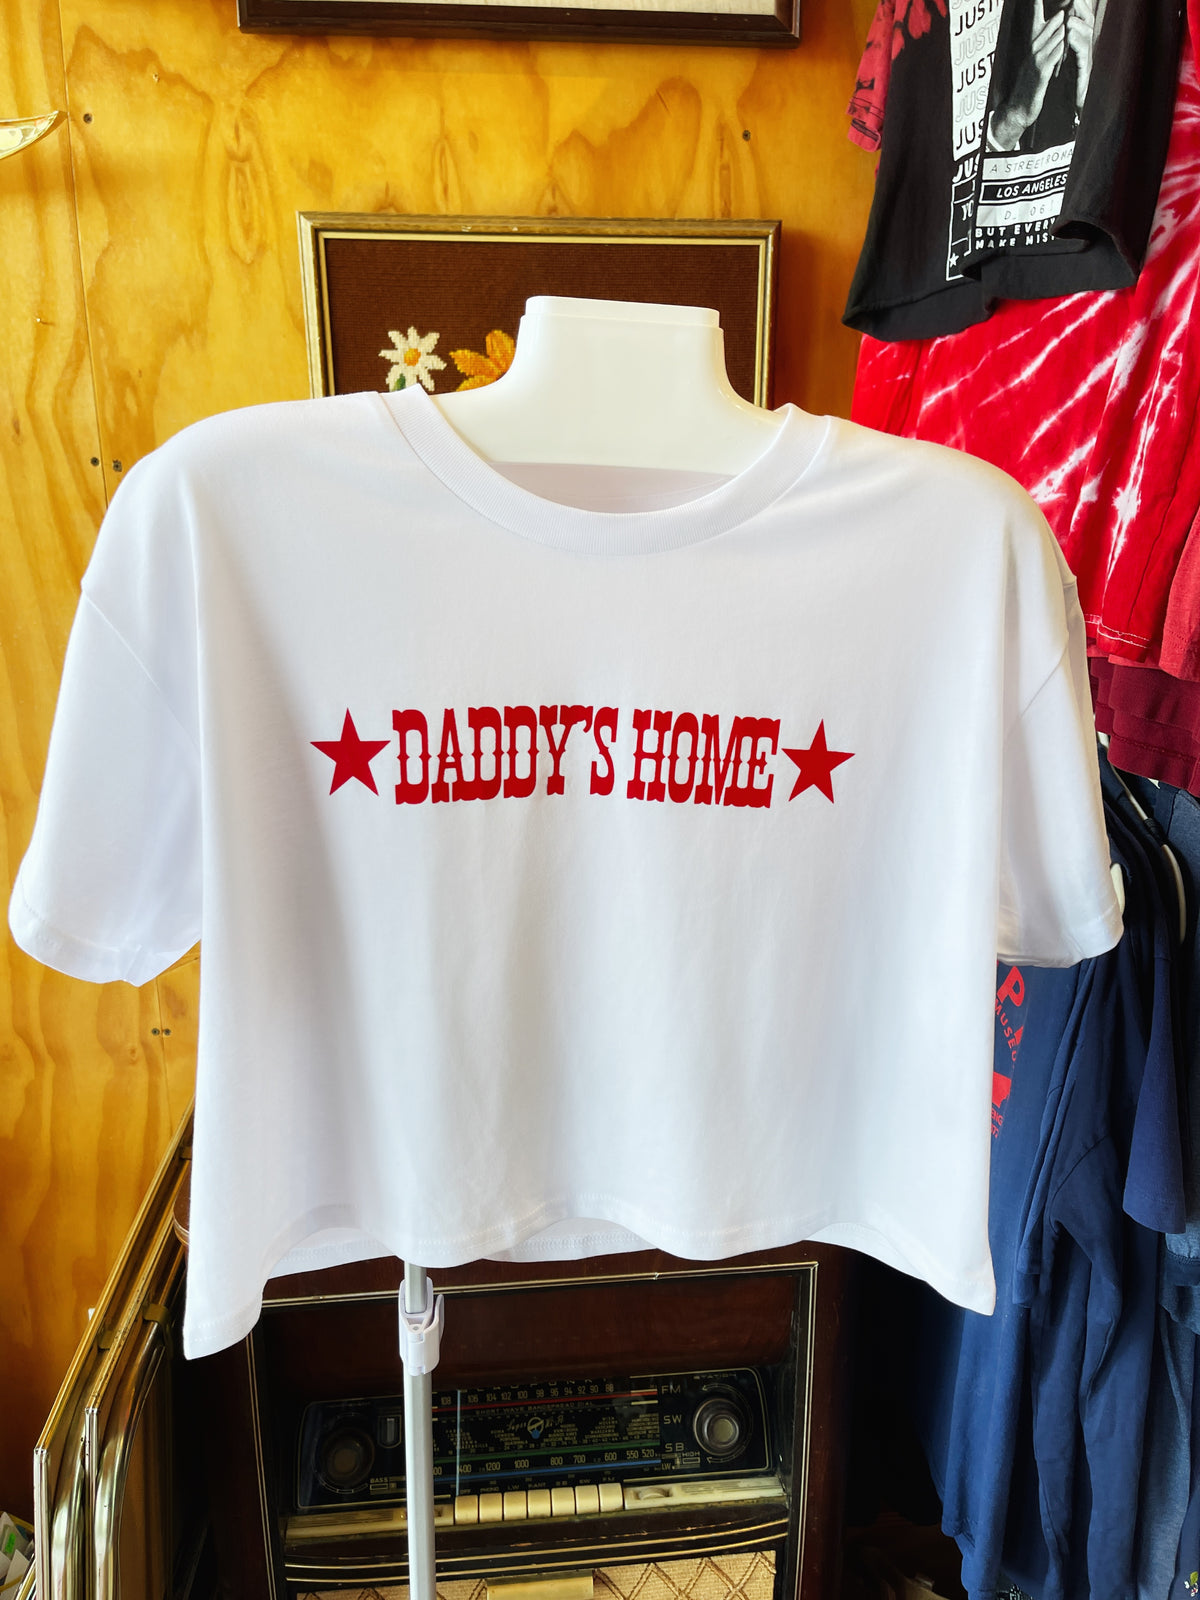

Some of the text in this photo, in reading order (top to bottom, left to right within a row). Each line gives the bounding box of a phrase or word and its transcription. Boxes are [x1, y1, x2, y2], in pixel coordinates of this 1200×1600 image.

[996, 173, 1068, 198] LOS ANGELES
[975, 227, 1006, 238] BUT
[975, 231, 1054, 250] MAKE MIS
[392, 704, 781, 808] DADDY'S HOME
[485, 1393, 497, 1402] 104
[501, 1391, 512, 1401] 102
[517, 1390, 528, 1399] 100
[535, 1388, 545, 1398] 98
[550, 1387, 559, 1397] 96
[563, 1386, 573, 1396] 94
[577, 1385, 586, 1394] 92
[589, 1384, 599, 1394] 90
[661, 1384, 681, 1394] FM
[663, 1414, 682, 1425] SW
[485, 1461, 501, 1471] 1200
[514, 1459, 530, 1469] 1000
[550, 1456, 564, 1466] 800
[572, 1454, 586, 1464] 700
[604, 1452, 618, 1462] 600
[626, 1450, 639, 1460] 550
[641, 1448, 655, 1458] 520
